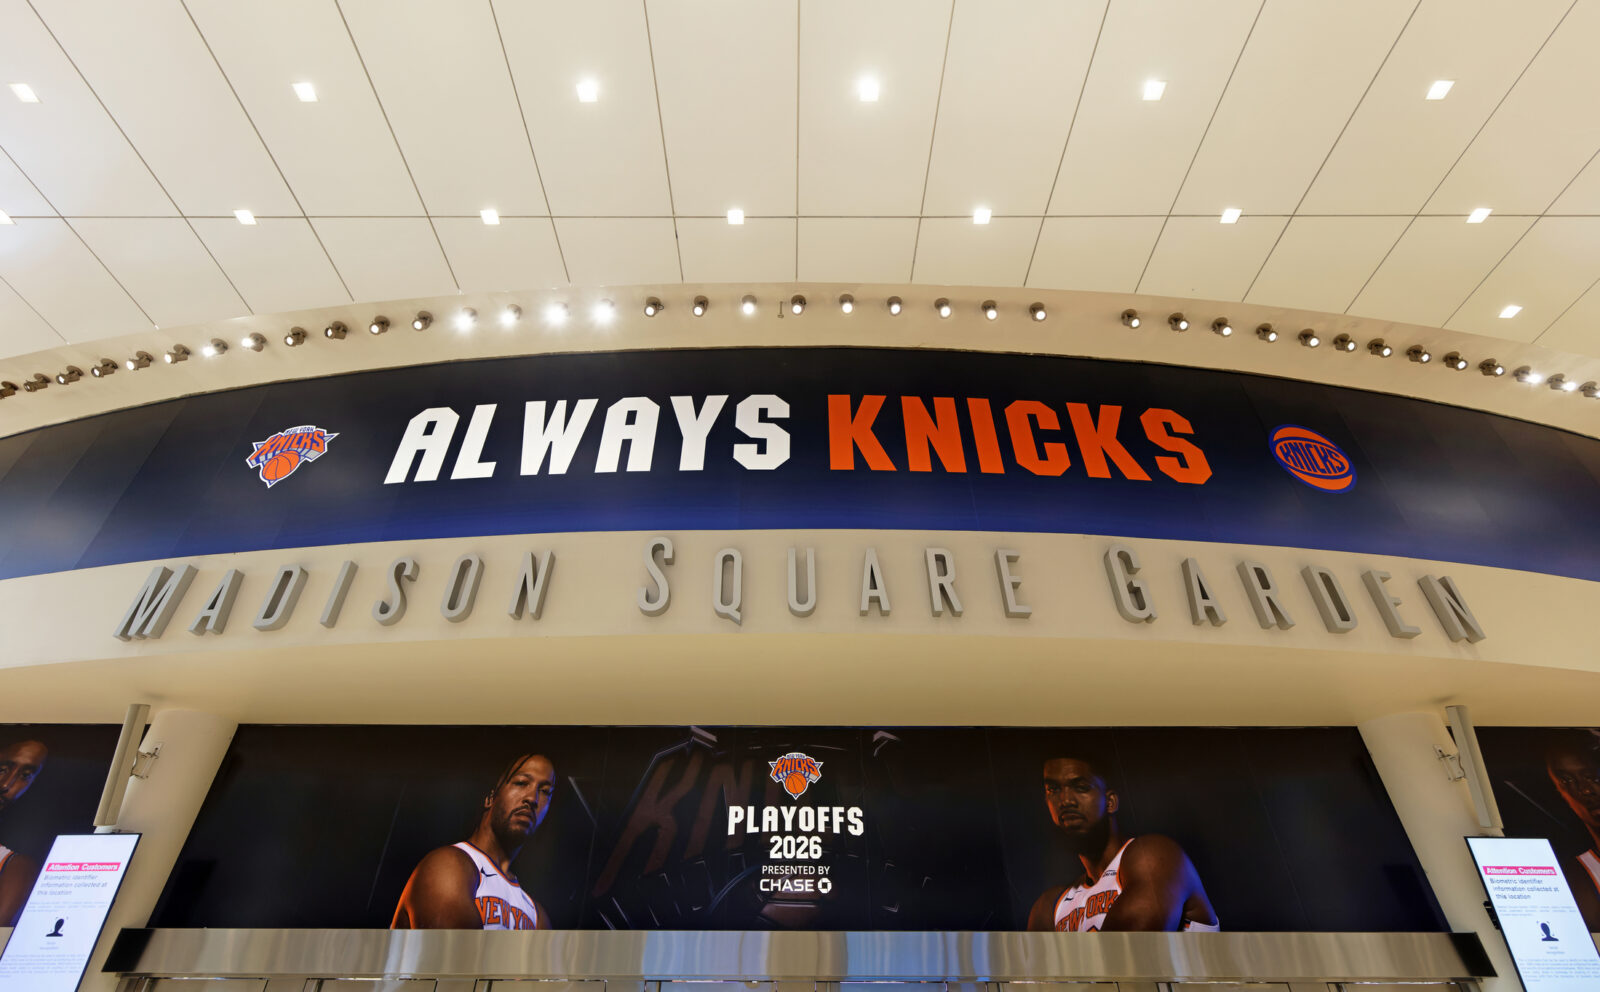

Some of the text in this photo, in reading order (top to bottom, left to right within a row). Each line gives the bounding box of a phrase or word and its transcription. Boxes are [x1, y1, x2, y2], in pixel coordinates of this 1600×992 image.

[249, 430, 325, 461] KNICKS
[383, 394, 1213, 485] ALWAYS KNICKS
[1279, 441, 1346, 474] KNICKS
[112, 536, 1487, 645] MADISON SQUARE GARDEN
[772, 757, 820, 777] KNICKS
[727, 805, 864, 836] PLAYOFFS
[769, 835, 822, 859] 2026
[48, 863, 118, 871] Attention Customers
[762, 865, 830, 875] PRESENTED BY
[760, 878, 815, 891] CHASE
[1085, 890, 1119, 919] ORK
